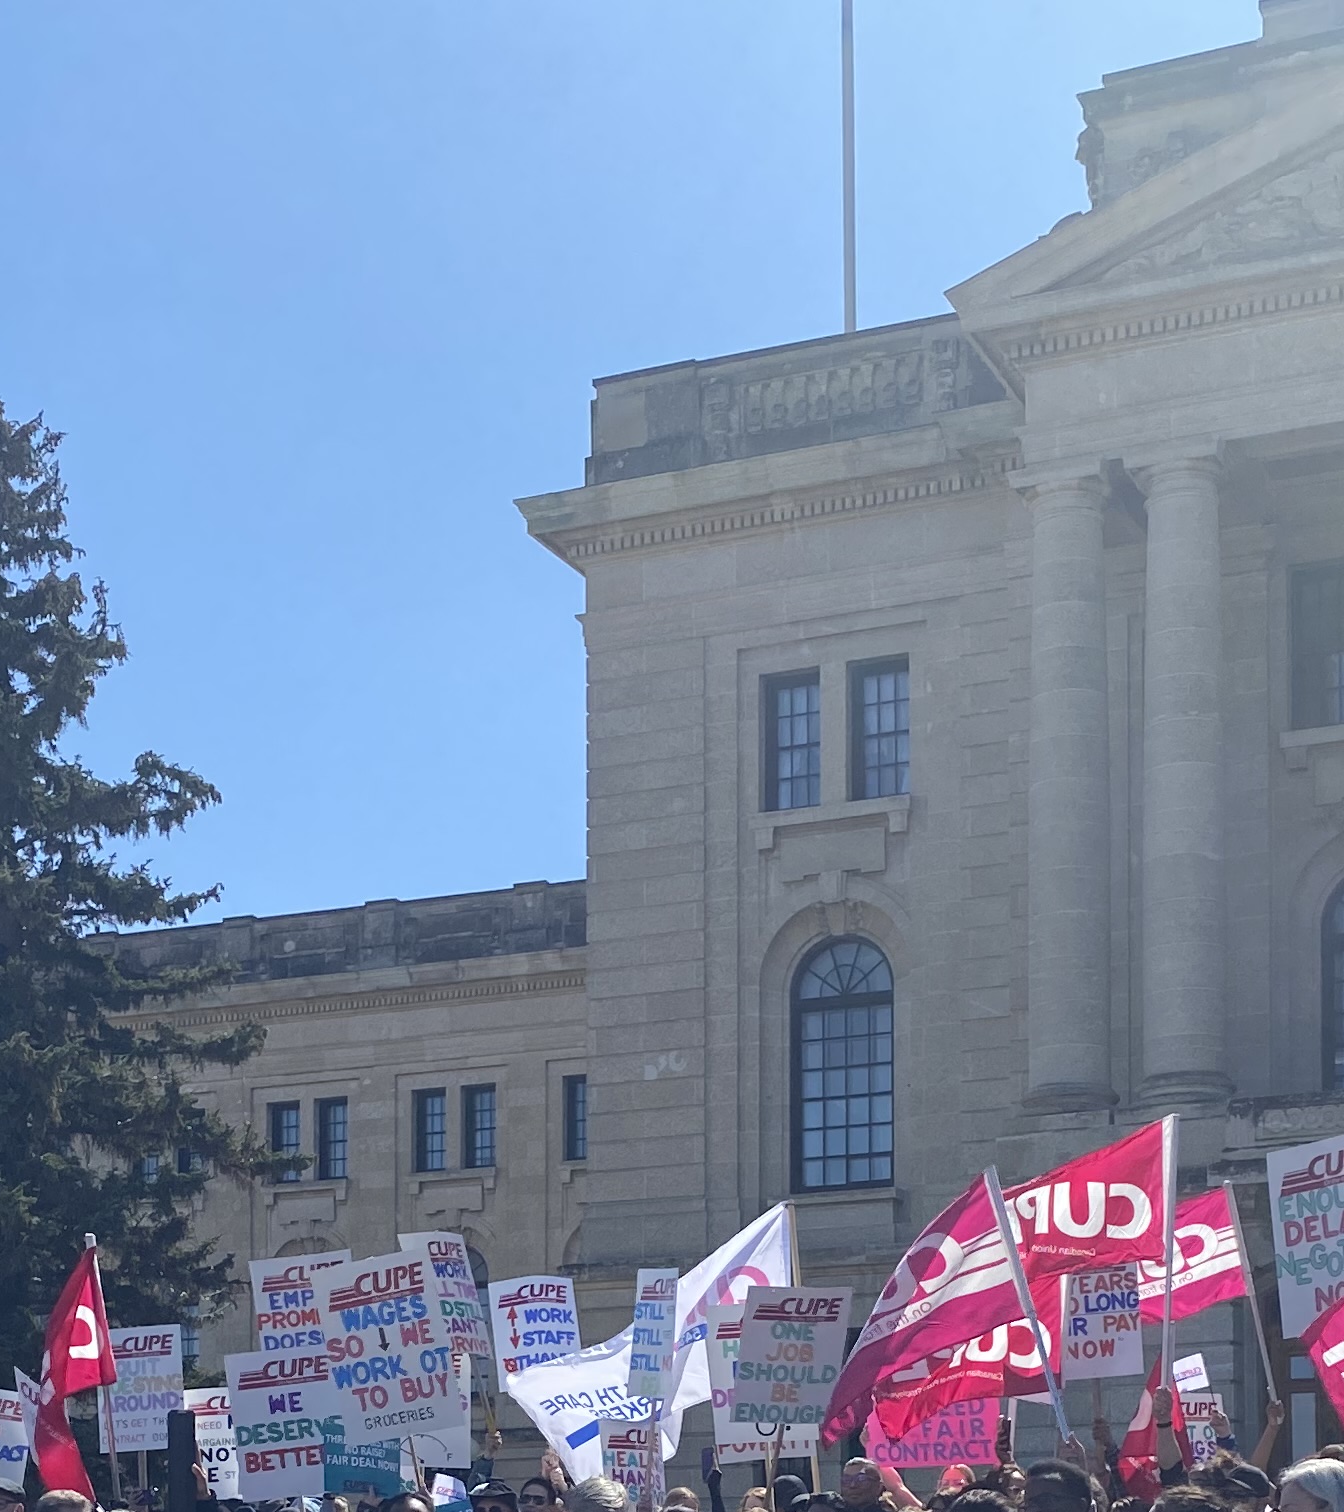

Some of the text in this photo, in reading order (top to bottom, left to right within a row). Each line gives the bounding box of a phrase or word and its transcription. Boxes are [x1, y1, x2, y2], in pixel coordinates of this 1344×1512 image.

[354, 1262, 424, 1298] CUPE
[517, 1284, 568, 1300] CUPE
[339, 1295, 428, 1332] WAGES
[524, 1308, 575, 1325] WORK
[779, 1297, 844, 1316] CUPE
[326, 1319, 435, 1362] SO WE
[522, 1330, 576, 1347] STAFF
[770, 1321, 816, 1341] ONE
[765, 1342, 815, 1363] JOB
[262, 1355, 329, 1379] CUPE
[332, 1346, 450, 1390] WORK OT
[738, 1361, 837, 1384] SHOULD
[268, 1391, 304, 1414] WE
[352, 1372, 449, 1412] TO BUY
[770, 1382, 801, 1403] BE
[364, 1407, 435, 1431] GROCERIES
[921, 1418, 985, 1439] FAIR
[873, 1440, 992, 1462] CONTRACT
